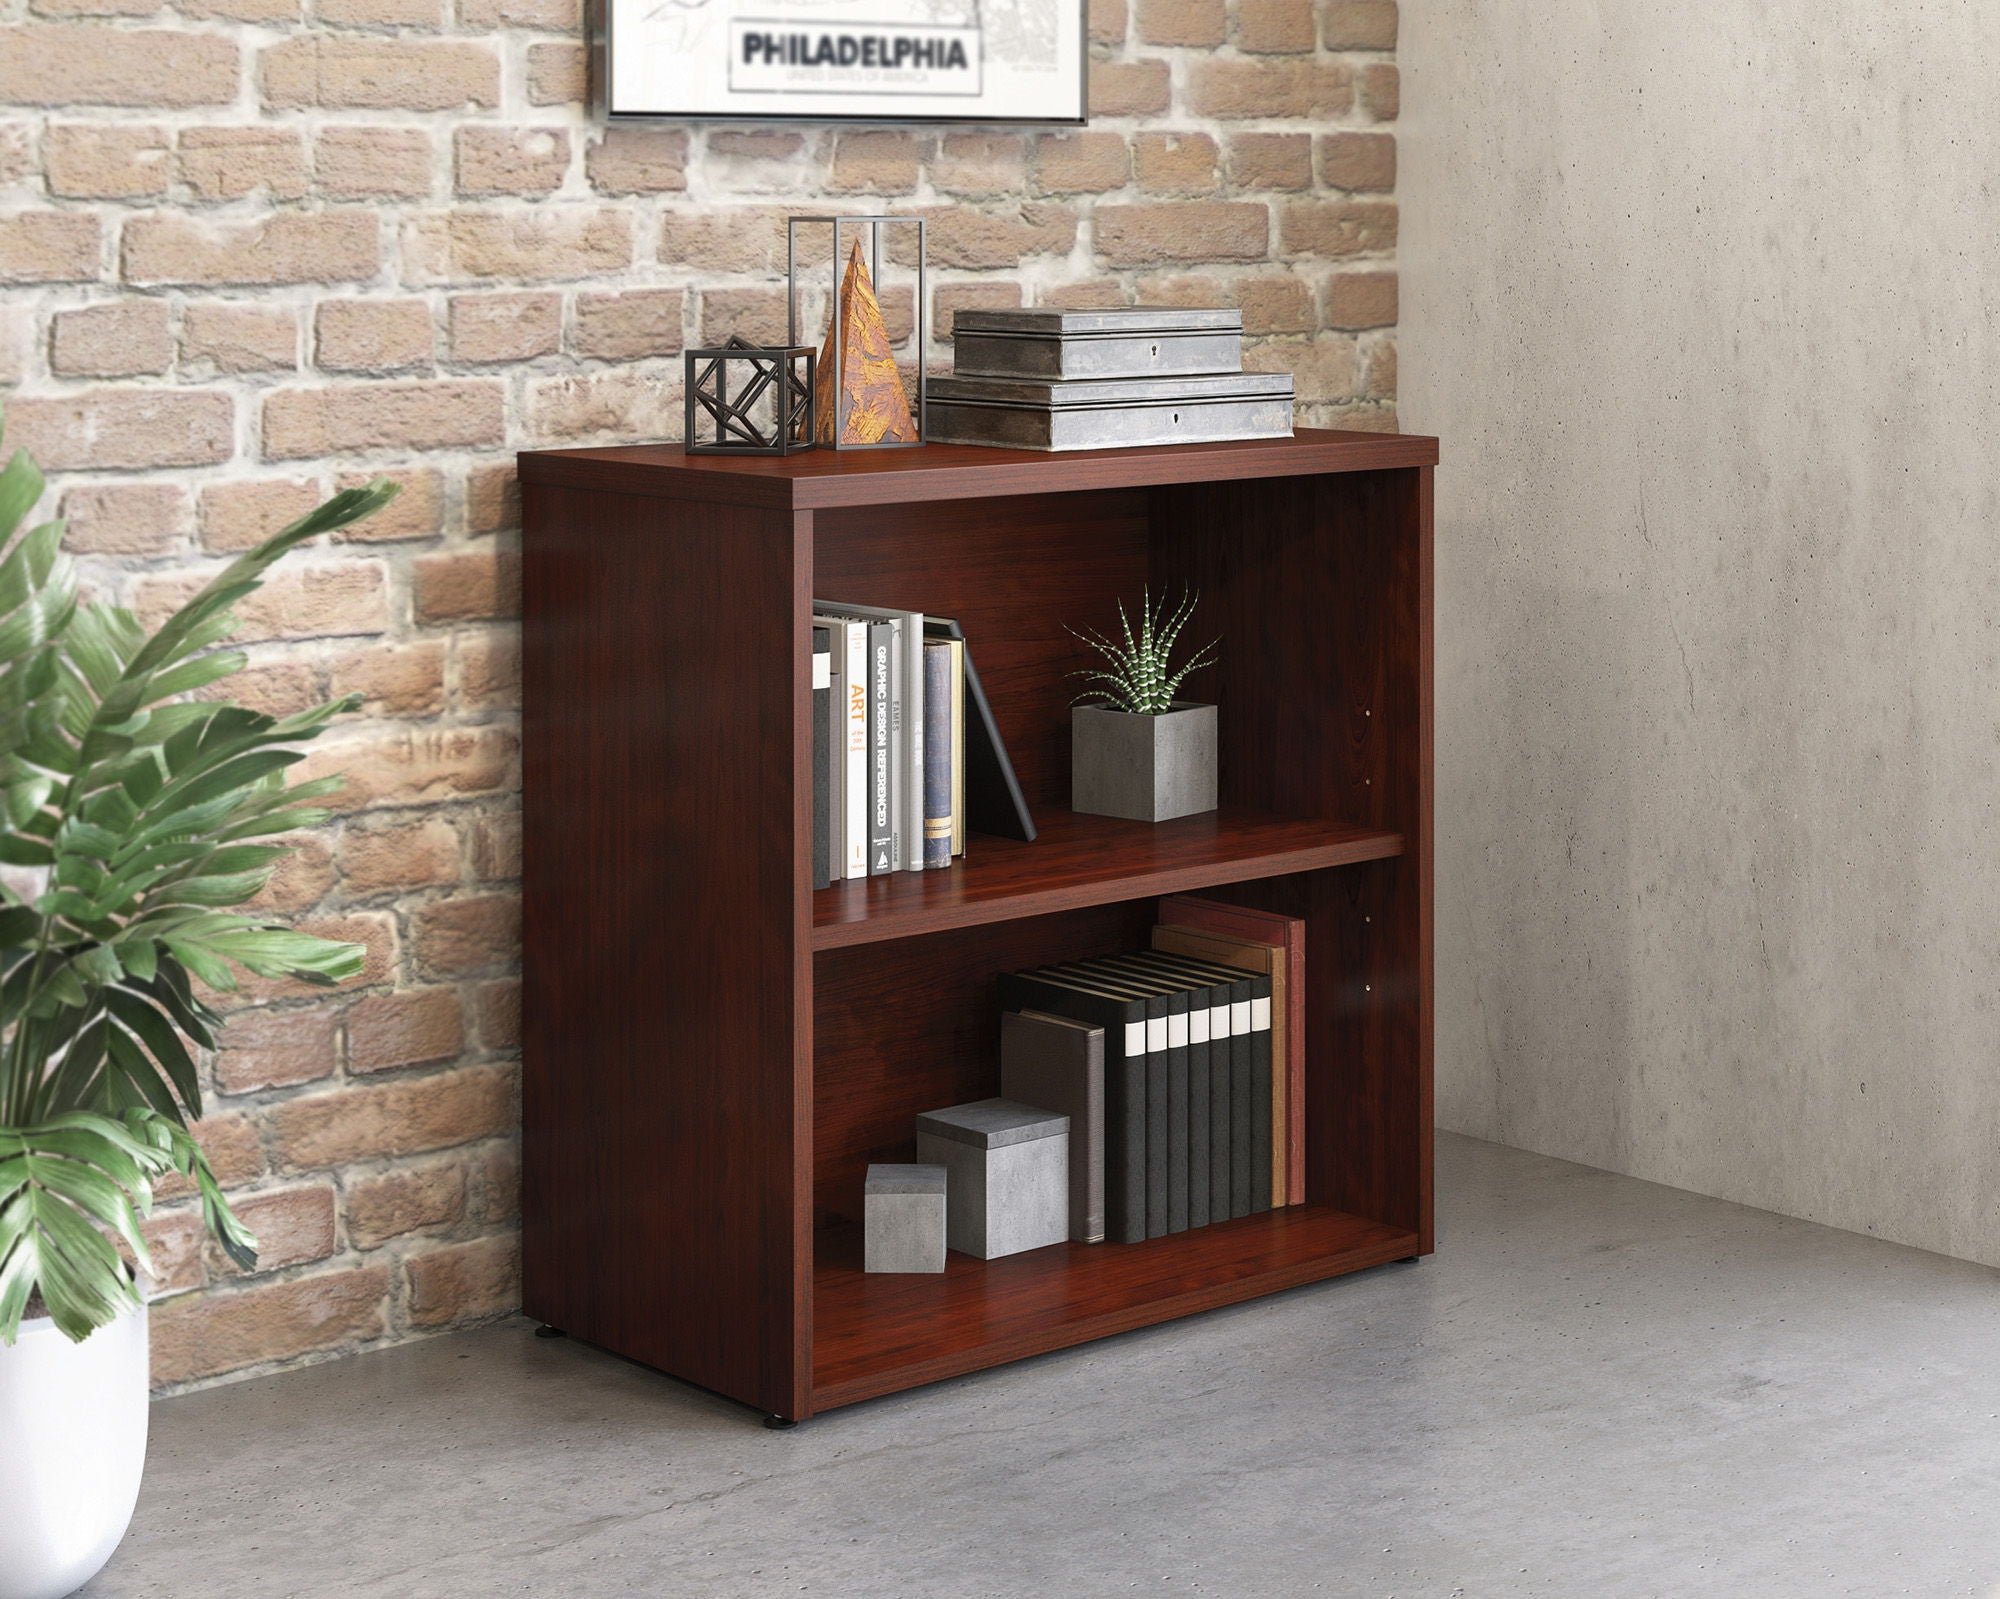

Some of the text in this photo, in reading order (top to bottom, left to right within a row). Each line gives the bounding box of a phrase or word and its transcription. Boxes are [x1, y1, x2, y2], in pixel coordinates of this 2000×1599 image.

[742, 32, 968, 70] PHILADELPHIA
[787, 69, 928, 83] UNITED STATES OF AMERICA
[877, 646, 887, 700] GRAPHIC
[851, 685, 865, 722] ART
[892, 701, 900, 732] EAMES
[877, 702, 887, 746] DESIGN
[877, 749, 887, 827] REFERENCED
